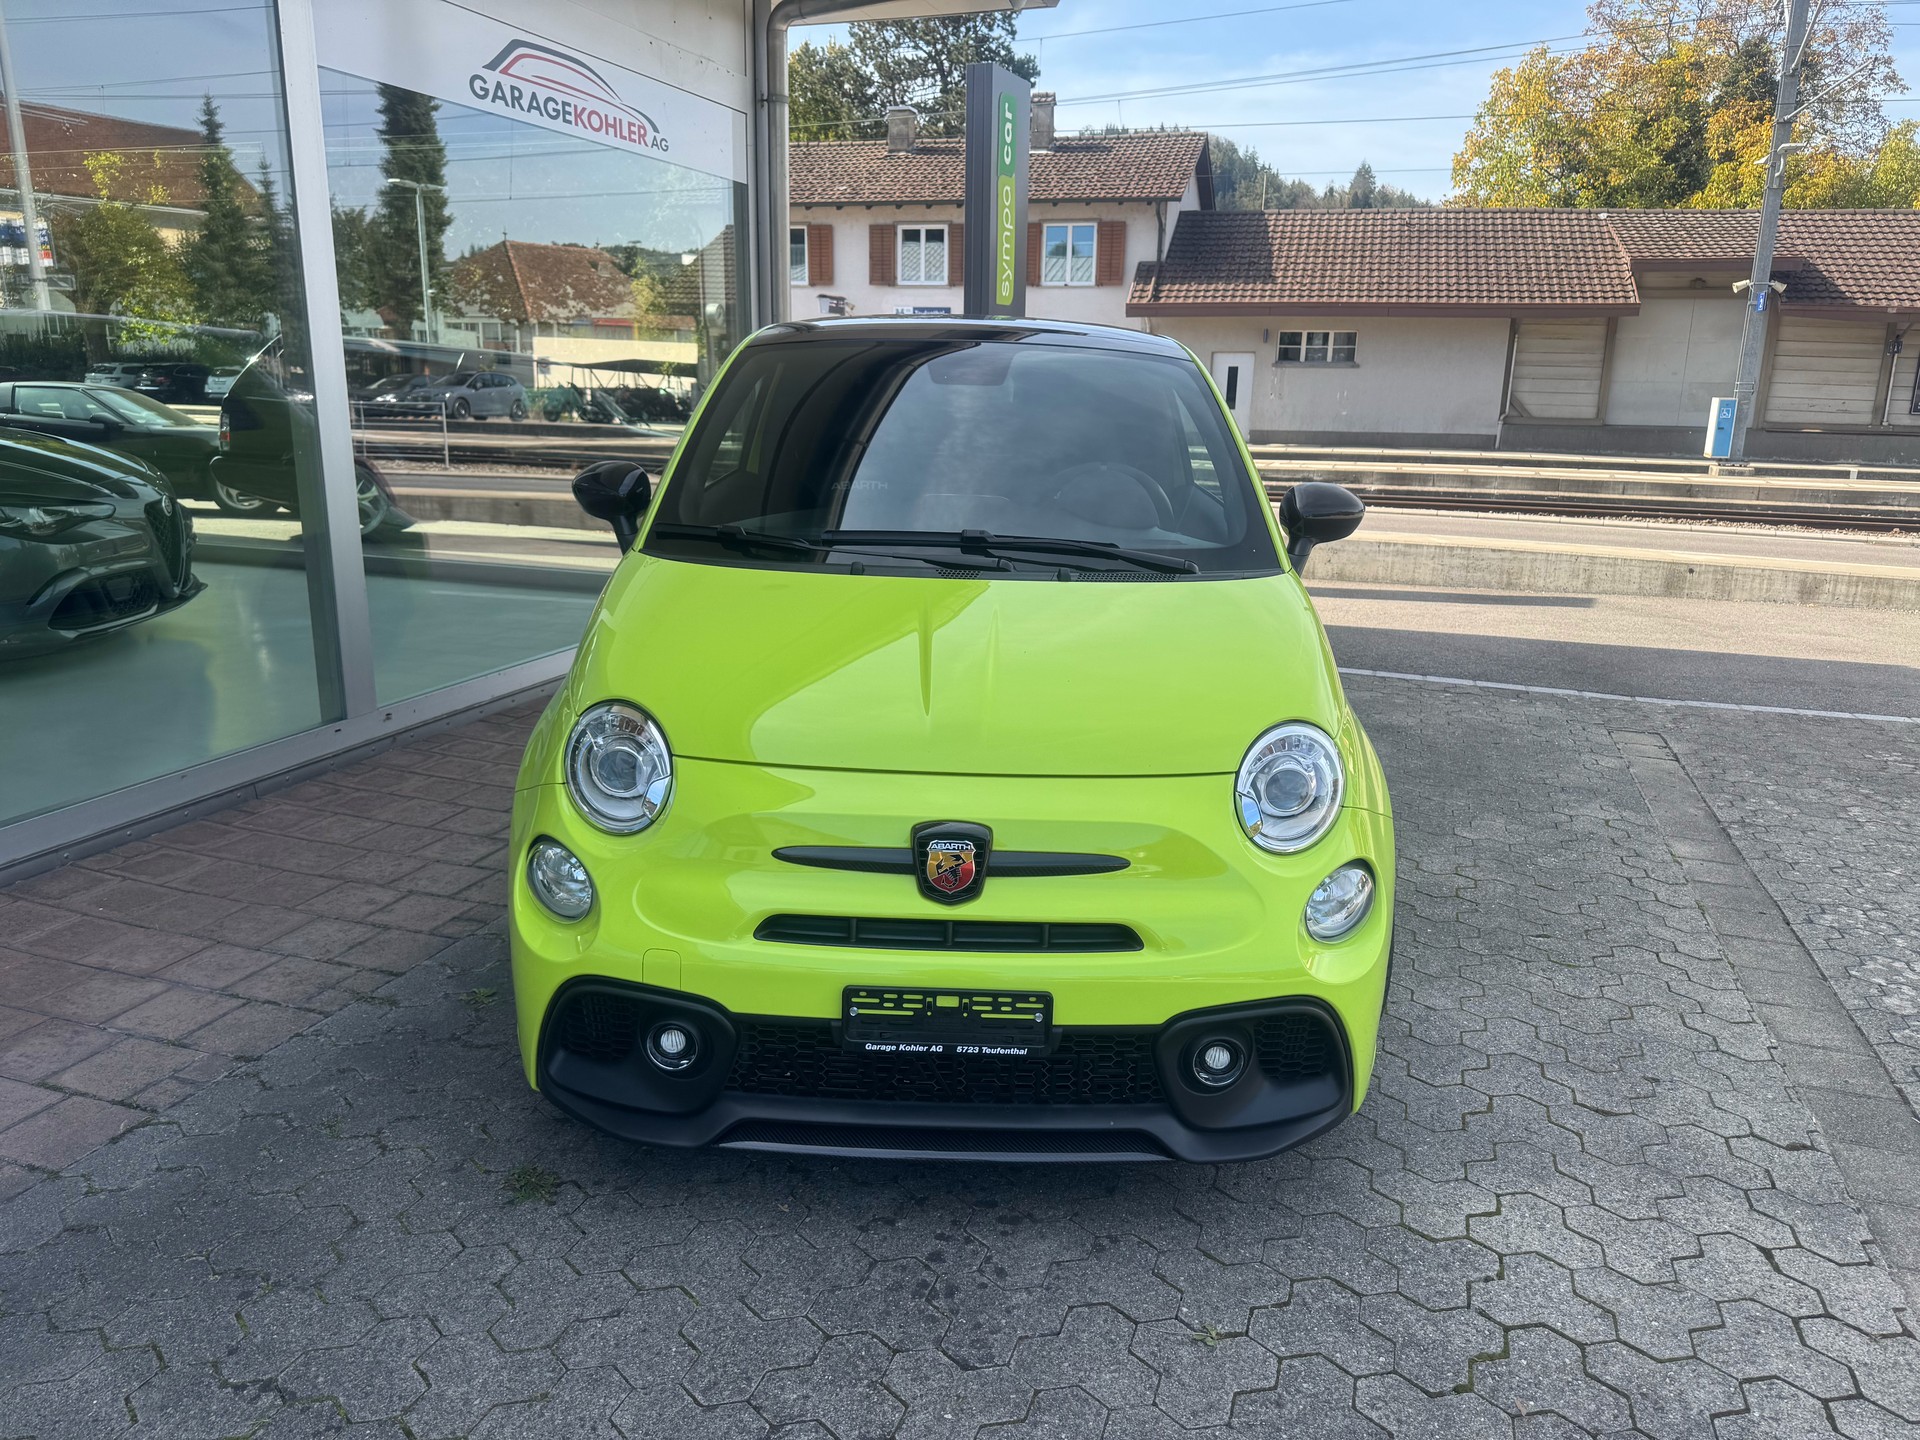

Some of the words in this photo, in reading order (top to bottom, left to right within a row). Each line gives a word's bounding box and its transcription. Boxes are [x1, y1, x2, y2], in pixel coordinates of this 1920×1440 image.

[1004, 102, 1013, 166] car
[650, 135, 670, 152] AG
[1002, 185, 1014, 297] sympa
[831, 480, 888, 490] ABARTH
[865, 1043, 897, 1052] Garage
[899, 1044, 929, 1052] Kohler
[981, 1047, 1028, 1055] Teufenthal
